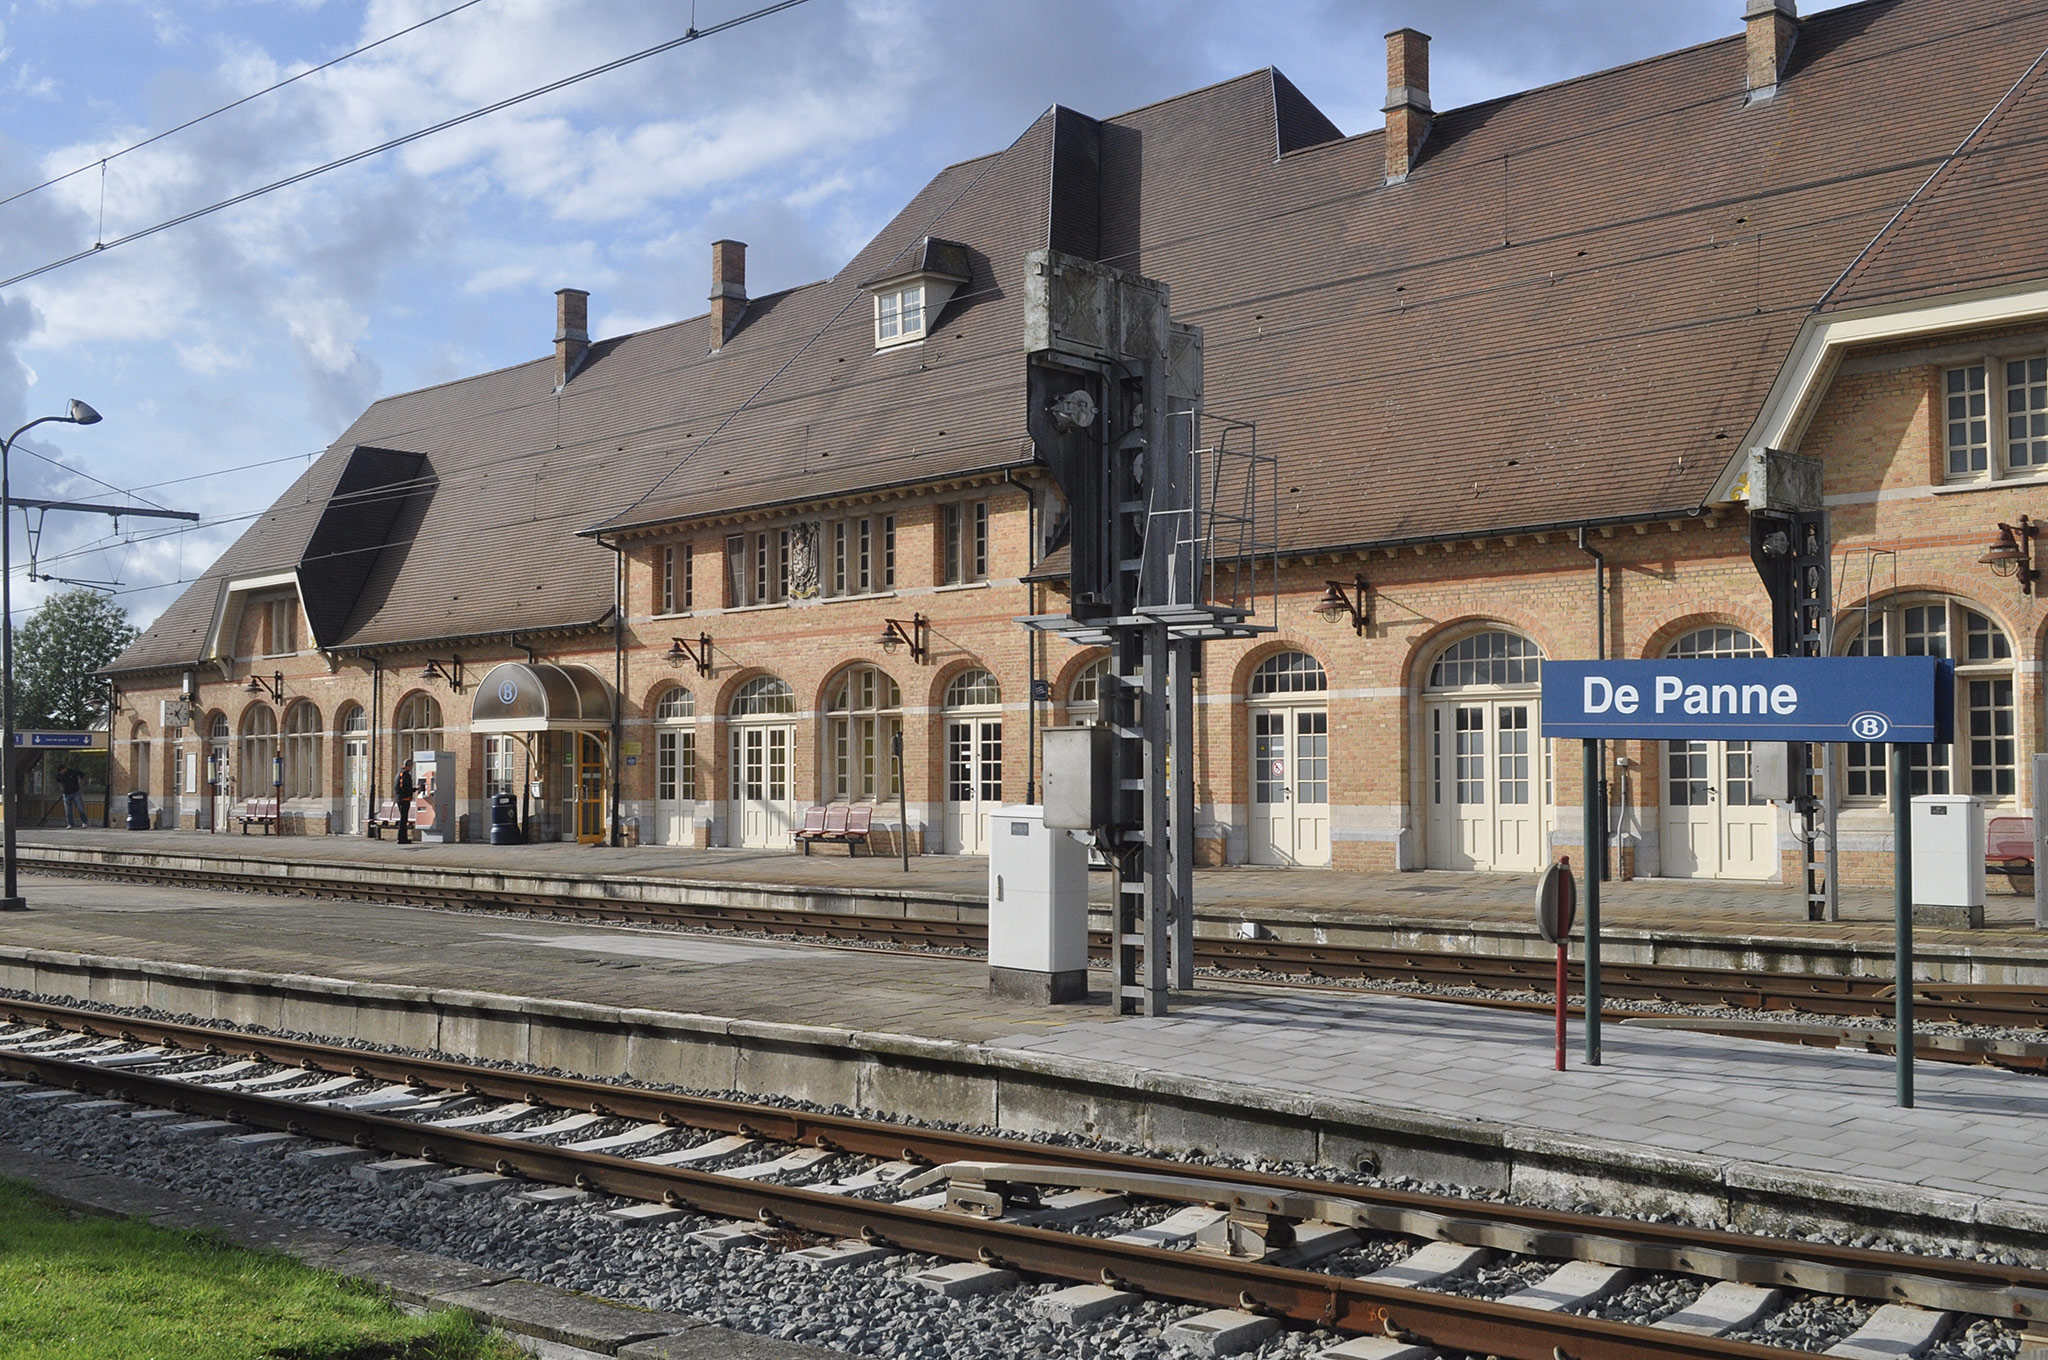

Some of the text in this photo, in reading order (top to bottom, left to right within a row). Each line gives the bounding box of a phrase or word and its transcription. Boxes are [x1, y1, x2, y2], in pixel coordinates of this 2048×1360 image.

[1583, 676, 1798, 715] De Panne
[1861, 718, 1879, 736] B
